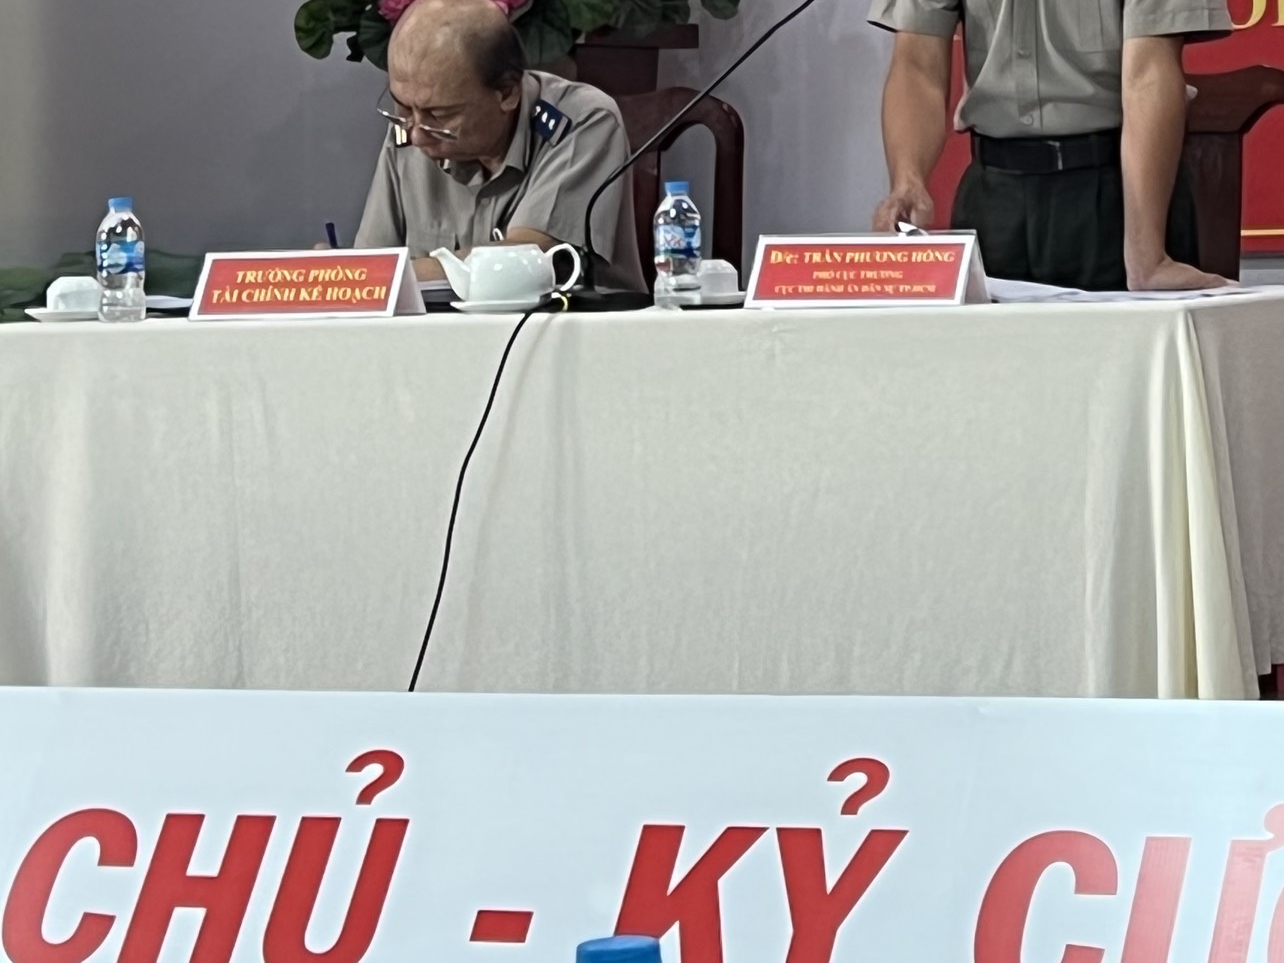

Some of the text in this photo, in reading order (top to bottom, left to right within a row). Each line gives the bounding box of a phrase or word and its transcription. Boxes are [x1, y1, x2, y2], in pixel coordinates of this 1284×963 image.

[325, 285, 388, 304] HOẠCH
[2, 750, 411, 963] CHỦ
[613, 757, 910, 963] KỶ
